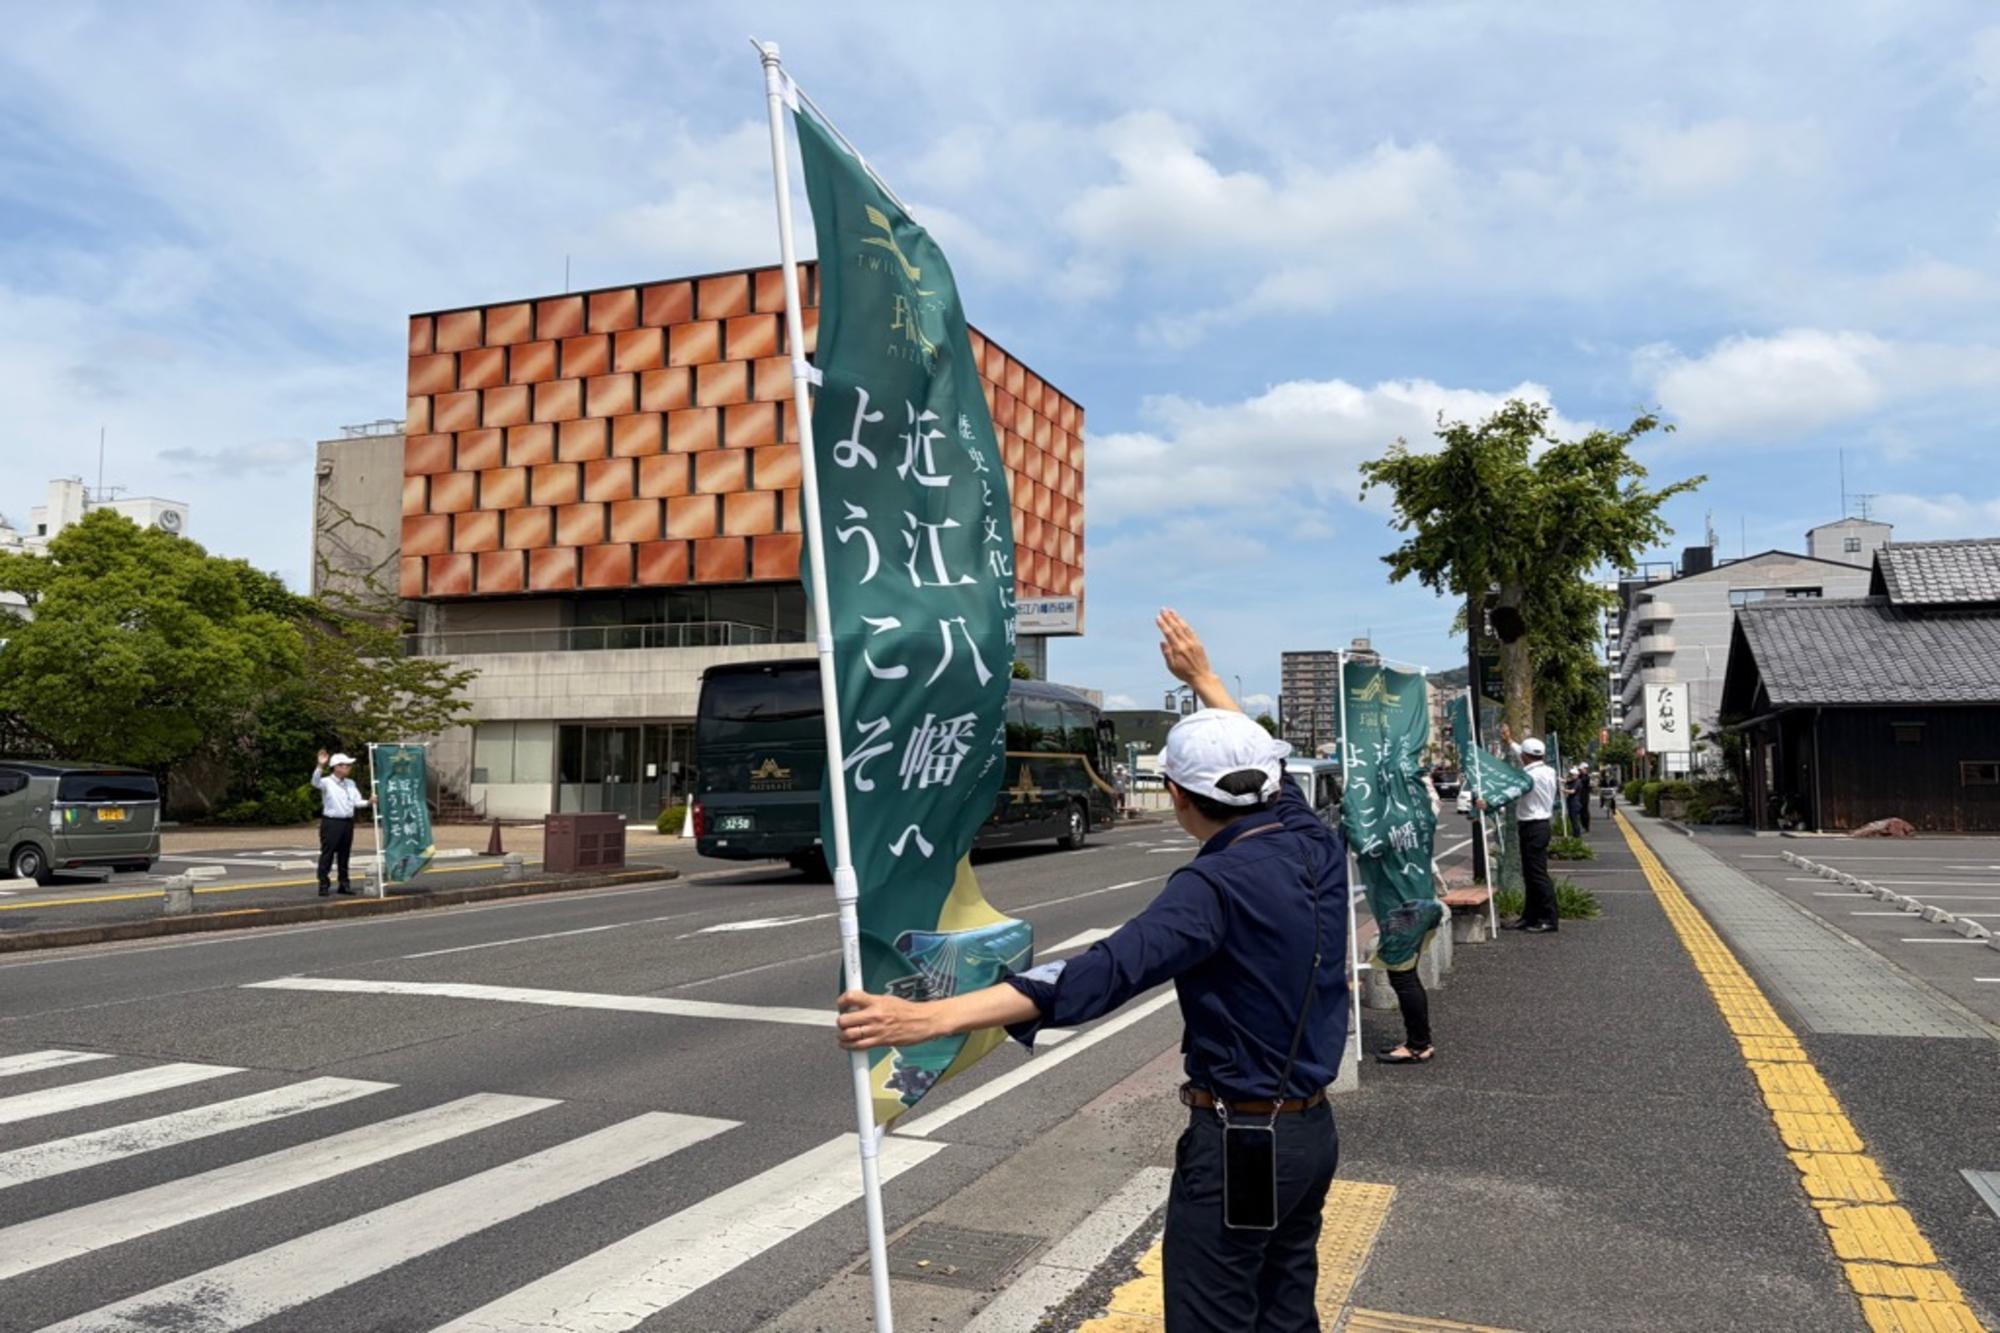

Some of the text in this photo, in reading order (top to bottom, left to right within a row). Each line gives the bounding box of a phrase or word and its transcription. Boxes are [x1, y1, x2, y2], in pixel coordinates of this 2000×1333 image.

[833, 386, 909, 792] ようこそ
[888, 400, 993, 858] 近江八幡へ
[387, 779, 402, 837] ようこそ
[1346, 743, 1384, 858] ようこそ
